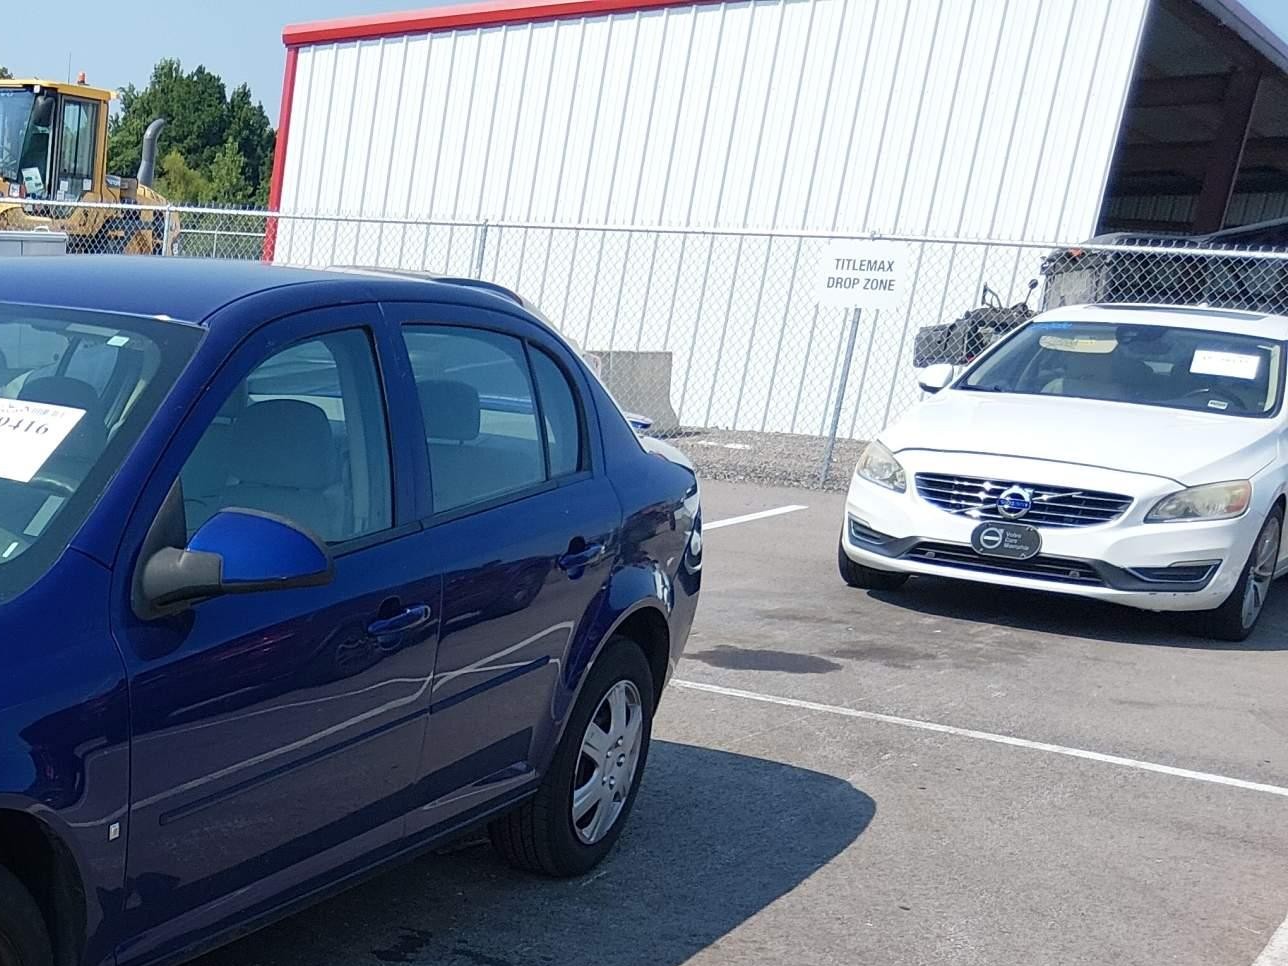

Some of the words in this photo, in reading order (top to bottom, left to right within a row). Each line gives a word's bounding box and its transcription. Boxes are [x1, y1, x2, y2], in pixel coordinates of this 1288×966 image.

[834, 258, 895, 272] TITLEMAX
[827, 276, 860, 289] DROP
[863, 278, 896, 291] ZONE
